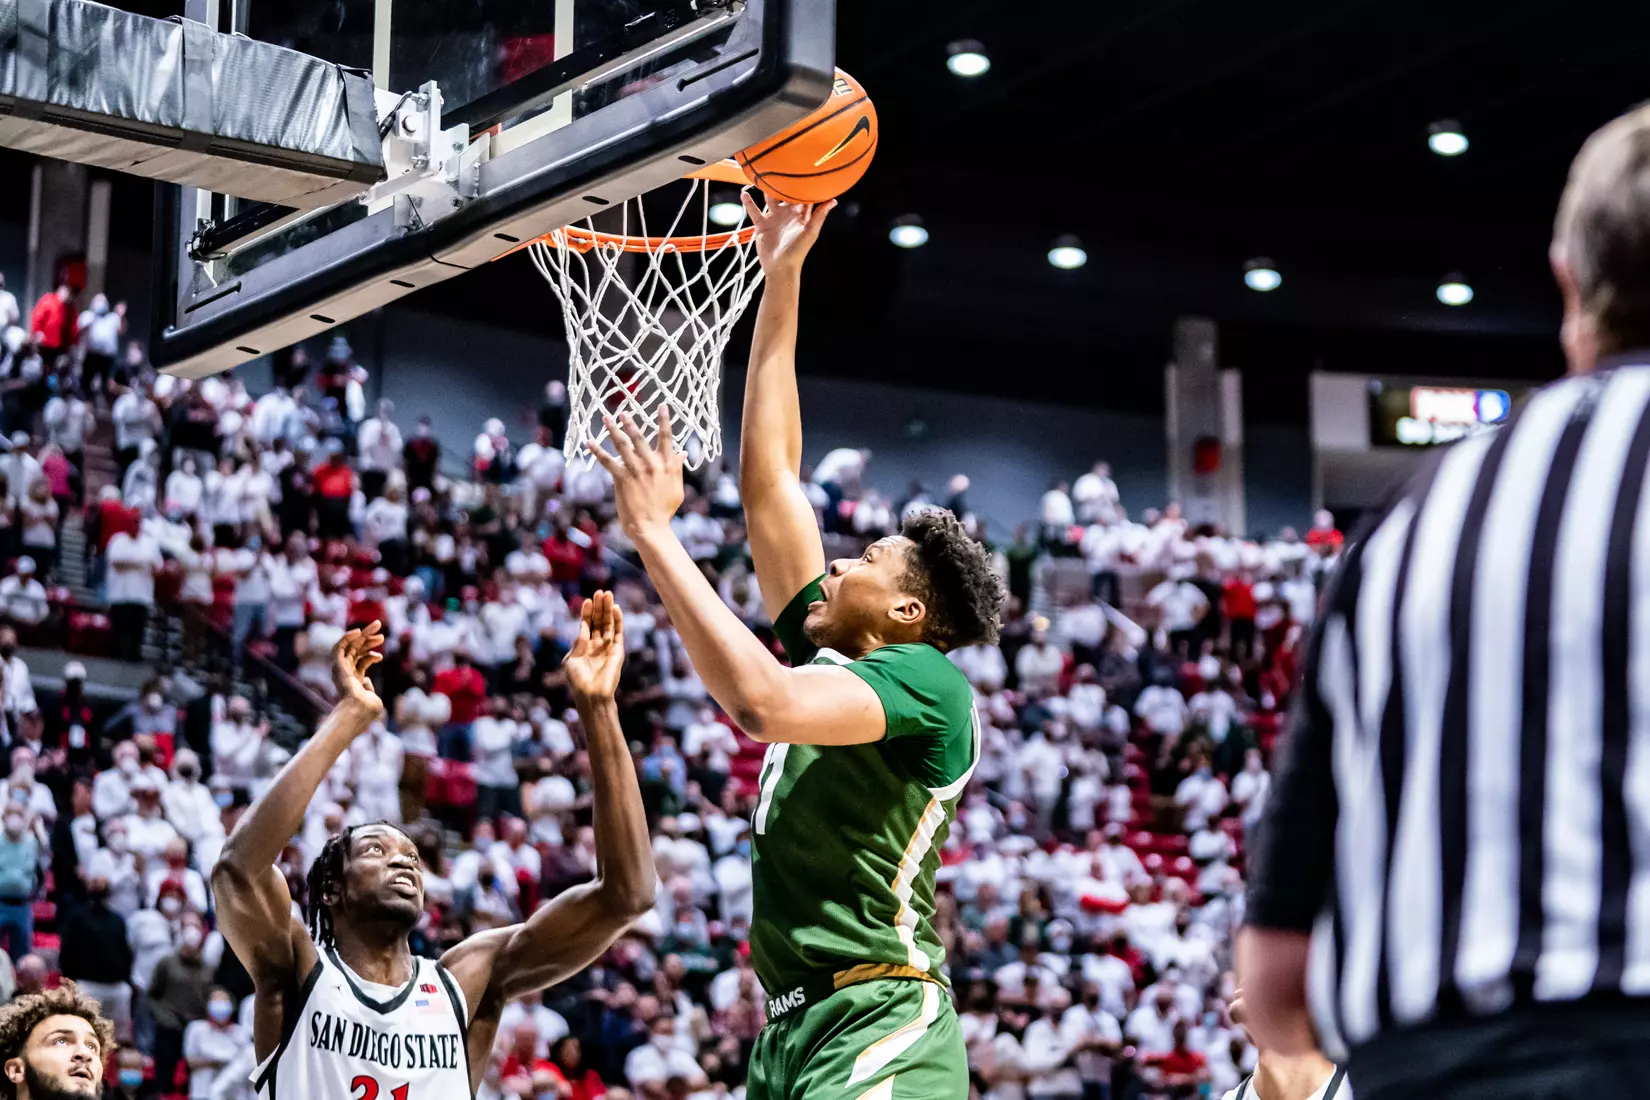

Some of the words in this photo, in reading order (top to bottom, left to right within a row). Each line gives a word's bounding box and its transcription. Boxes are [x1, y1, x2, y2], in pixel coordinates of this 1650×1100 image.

[769, 986, 806, 1018] RAMS
[310, 1011, 347, 1053] SAN
[348, 1022, 401, 1068] DIEGO
[404, 1034, 458, 1069] STATE
